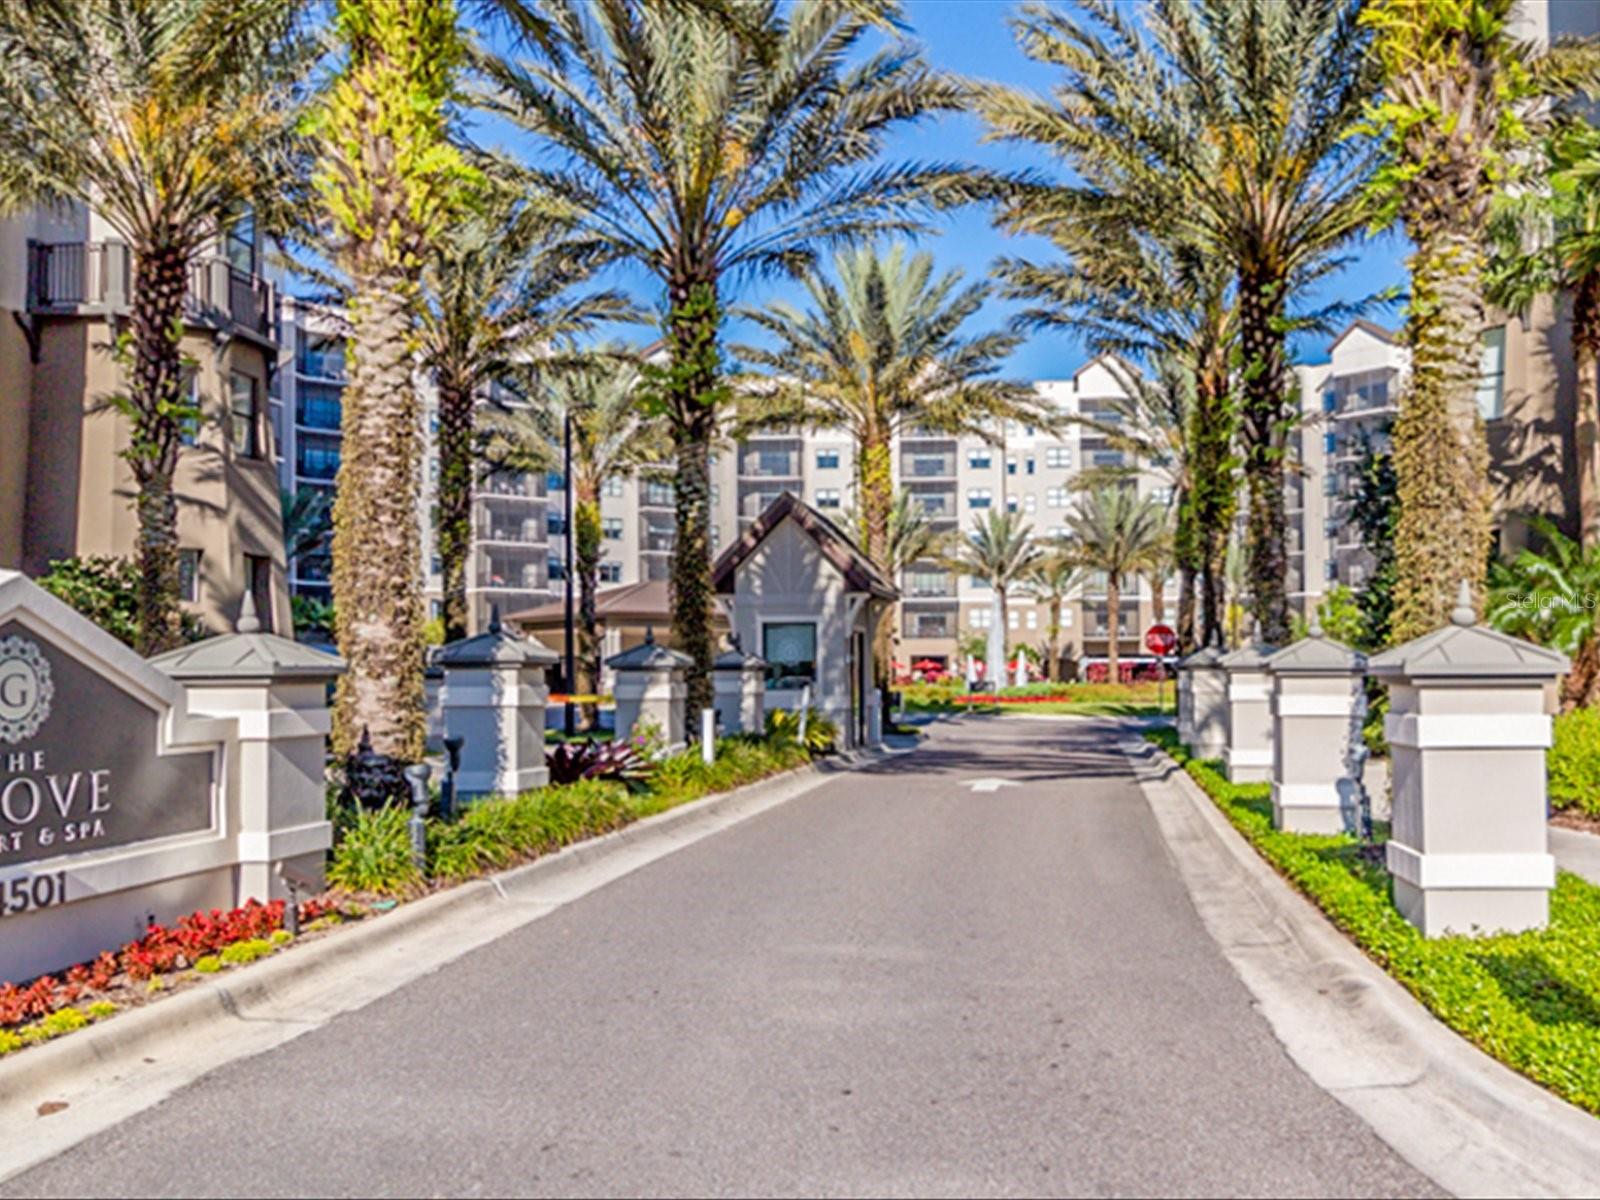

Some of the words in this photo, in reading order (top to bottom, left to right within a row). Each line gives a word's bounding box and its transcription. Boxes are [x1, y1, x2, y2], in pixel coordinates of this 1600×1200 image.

[1, 673, 27, 708] G
[0, 750, 45, 773] HE
[1, 769, 112, 825] OVE
[38, 826, 55, 847] &
[64, 819, 105, 842] SPA
